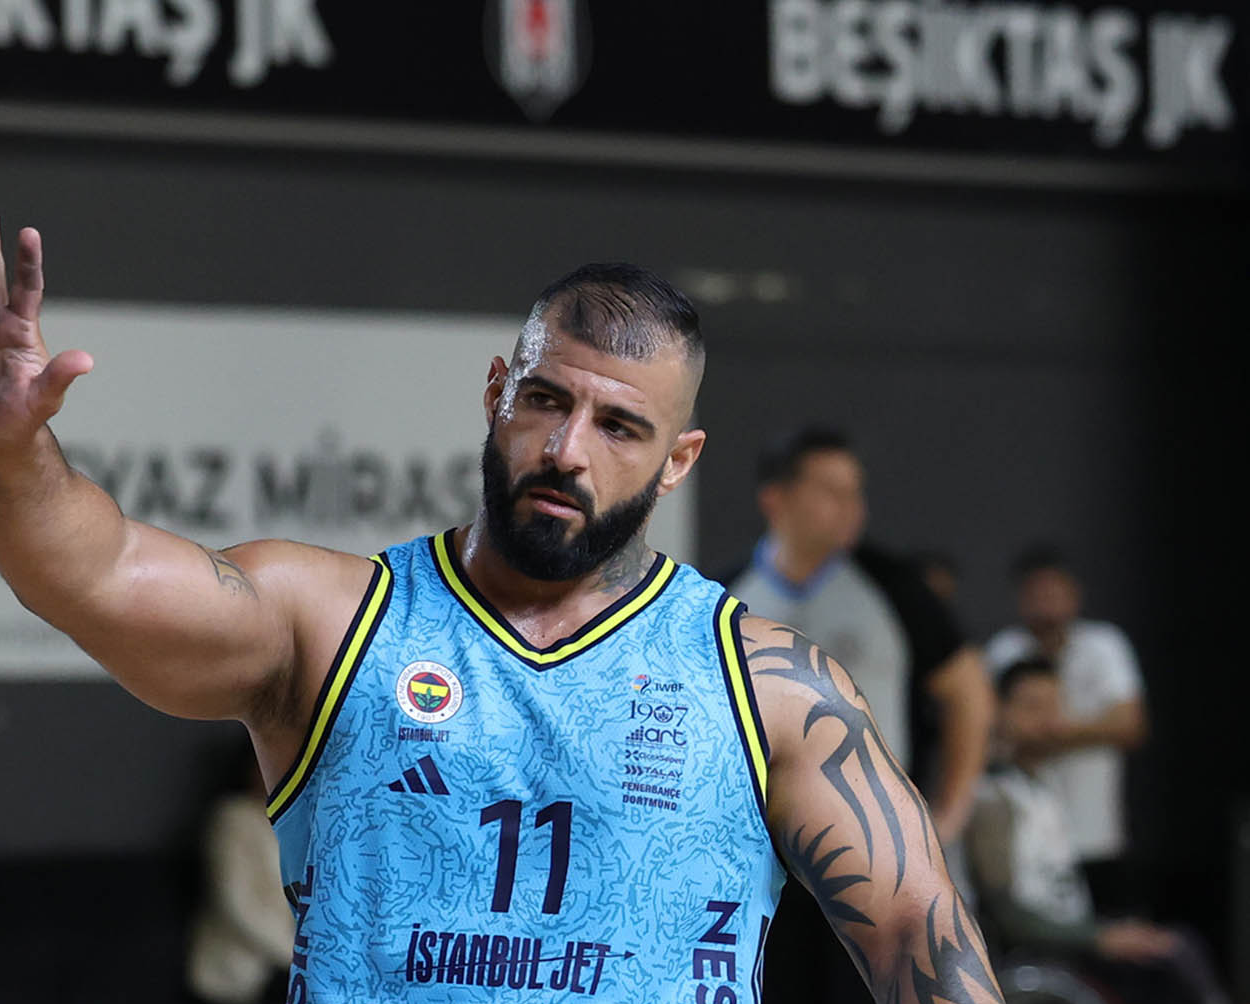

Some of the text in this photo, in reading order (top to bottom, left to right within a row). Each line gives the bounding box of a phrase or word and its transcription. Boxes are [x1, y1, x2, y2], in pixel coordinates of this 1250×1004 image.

[1144, 14, 1236, 150] JK
[654, 682, 685, 693] IWBF
[434, 729, 450, 743] JET
[643, 766, 683, 779] TALAY
[621, 781, 682, 800] FENERBAHÇE
[621, 794, 678, 812] DORTMUND
[478, 798, 573, 915] 11
[405, 922, 612, 996] İSTANBUL JET
